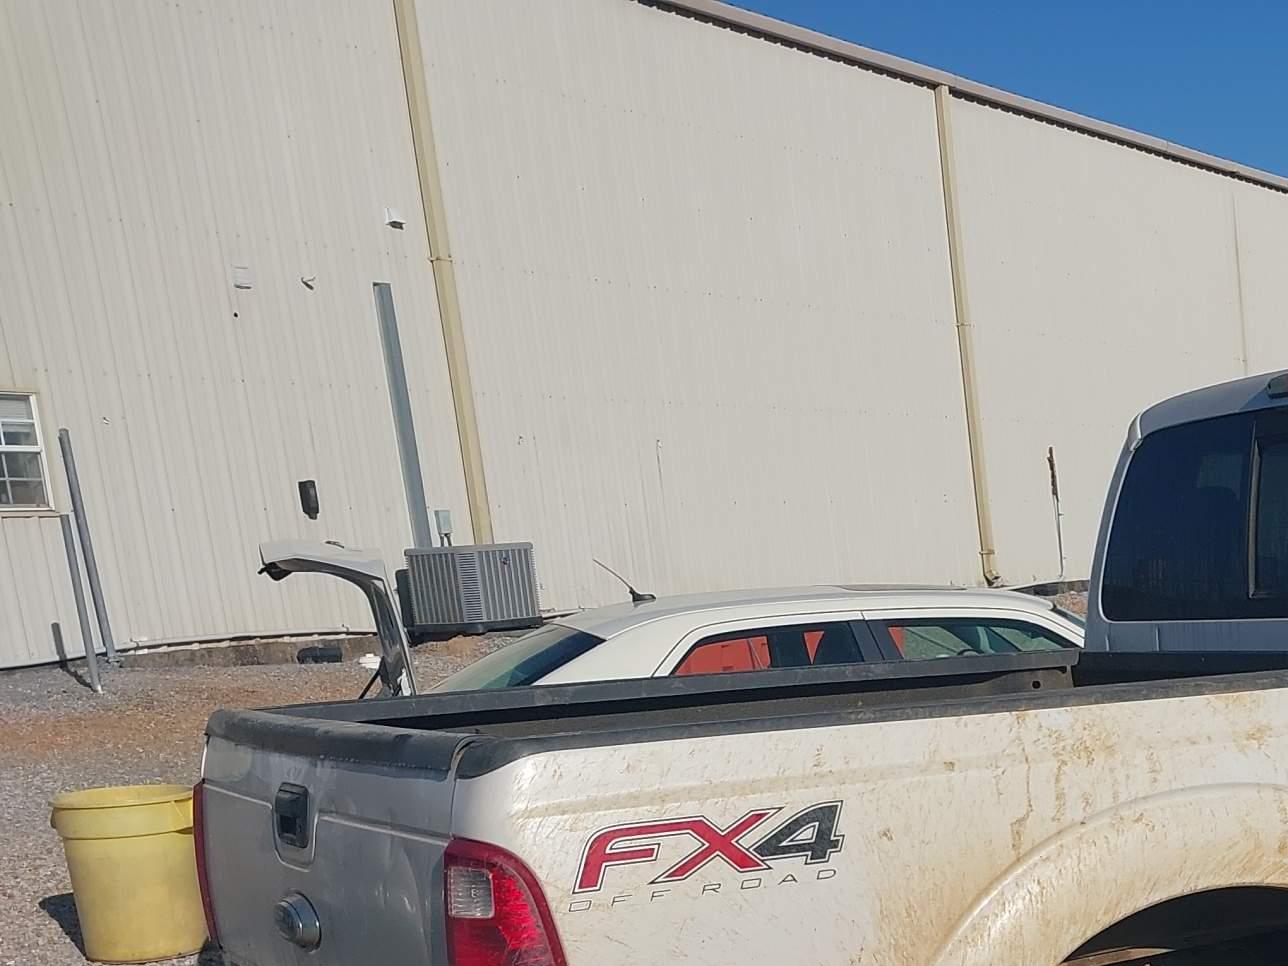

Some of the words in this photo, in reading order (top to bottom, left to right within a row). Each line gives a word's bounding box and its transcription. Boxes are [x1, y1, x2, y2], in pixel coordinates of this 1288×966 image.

[572, 800, 845, 894] FX4
[568, 889, 672, 913] OFF
[701, 868, 837, 895] ROAD
